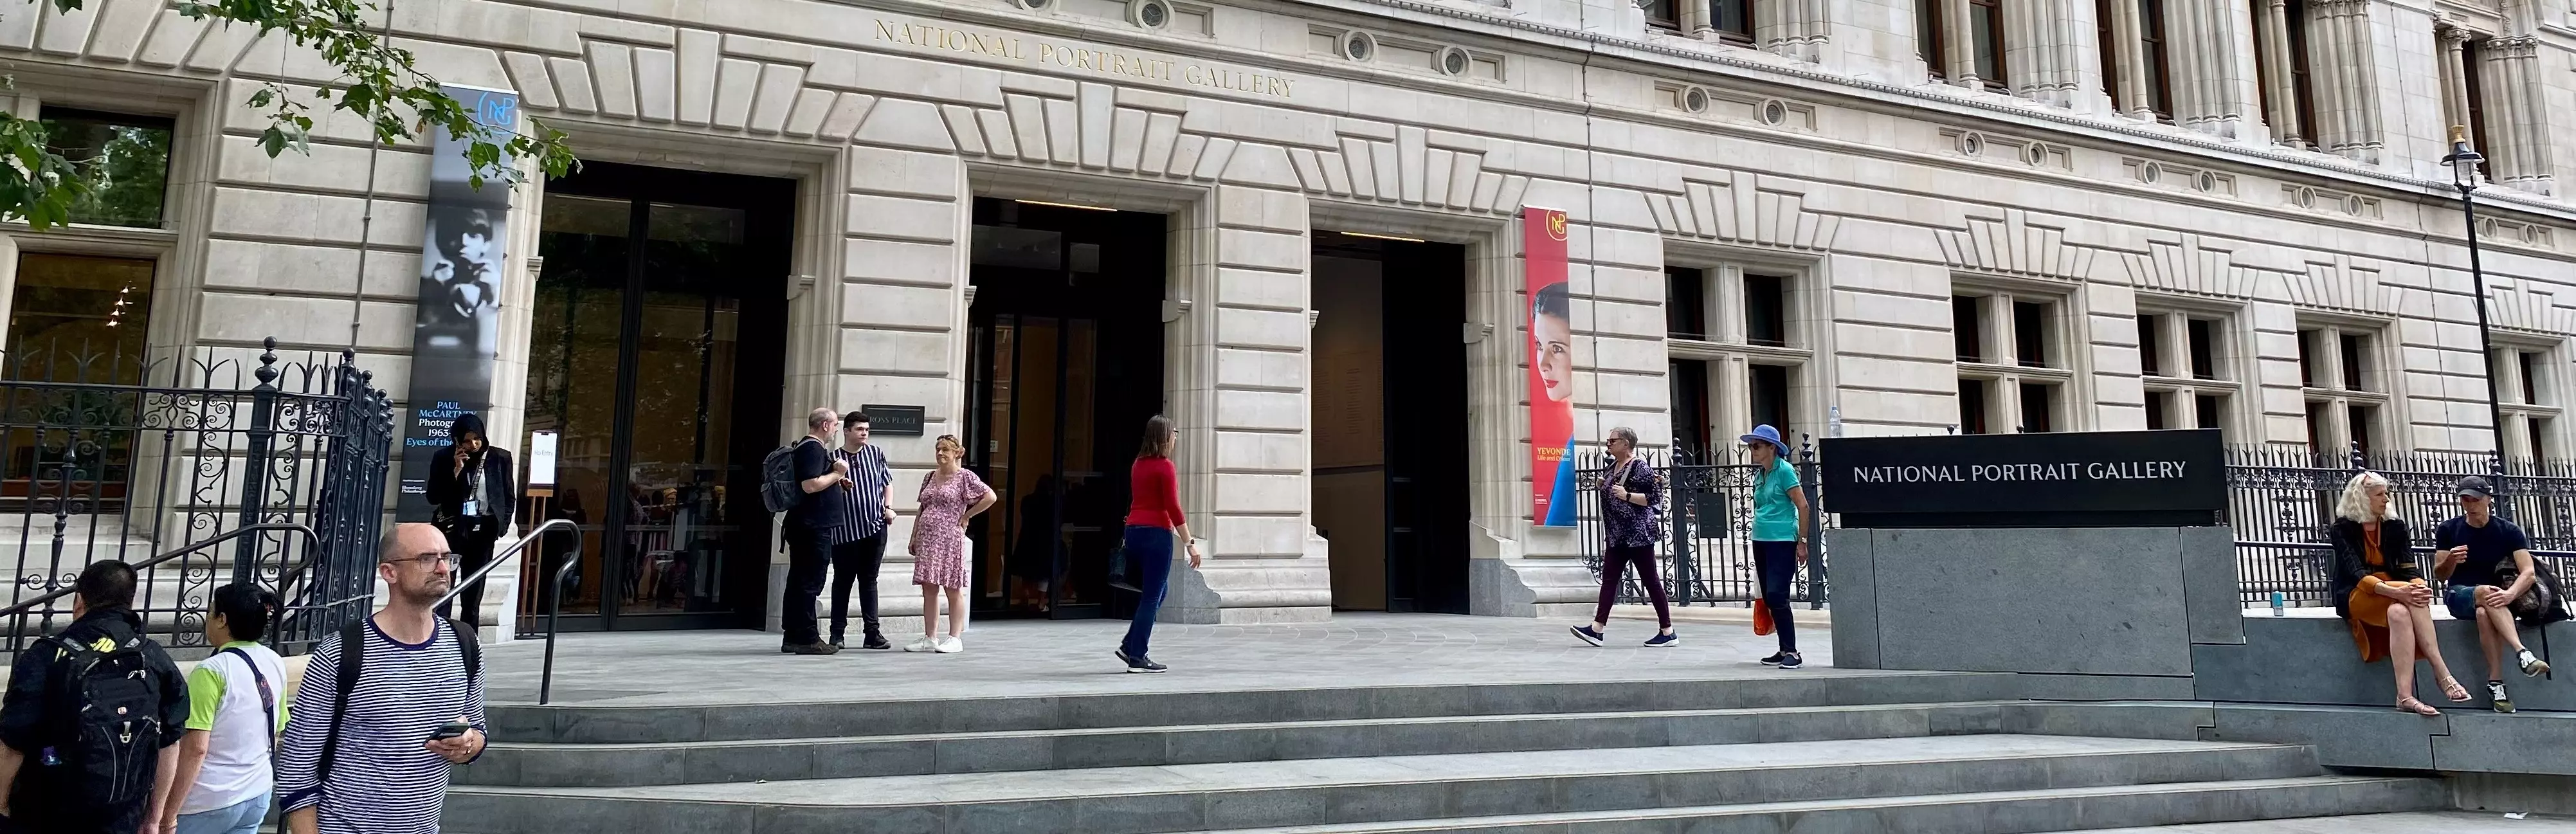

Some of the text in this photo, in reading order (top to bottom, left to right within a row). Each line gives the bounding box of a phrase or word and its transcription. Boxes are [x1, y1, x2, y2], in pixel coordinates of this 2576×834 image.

[875, 19, 1295, 98] NATIONAL PORTRAIT GALLERY
[419, 419, 455, 428] Photogr
[406, 438, 427, 447] Eyes
[428, 438, 439, 446] of
[1537, 447, 1571, 456] YEVONDE
[1854, 461, 2186, 483] NATIONAL PORTRAIT GALLERY
